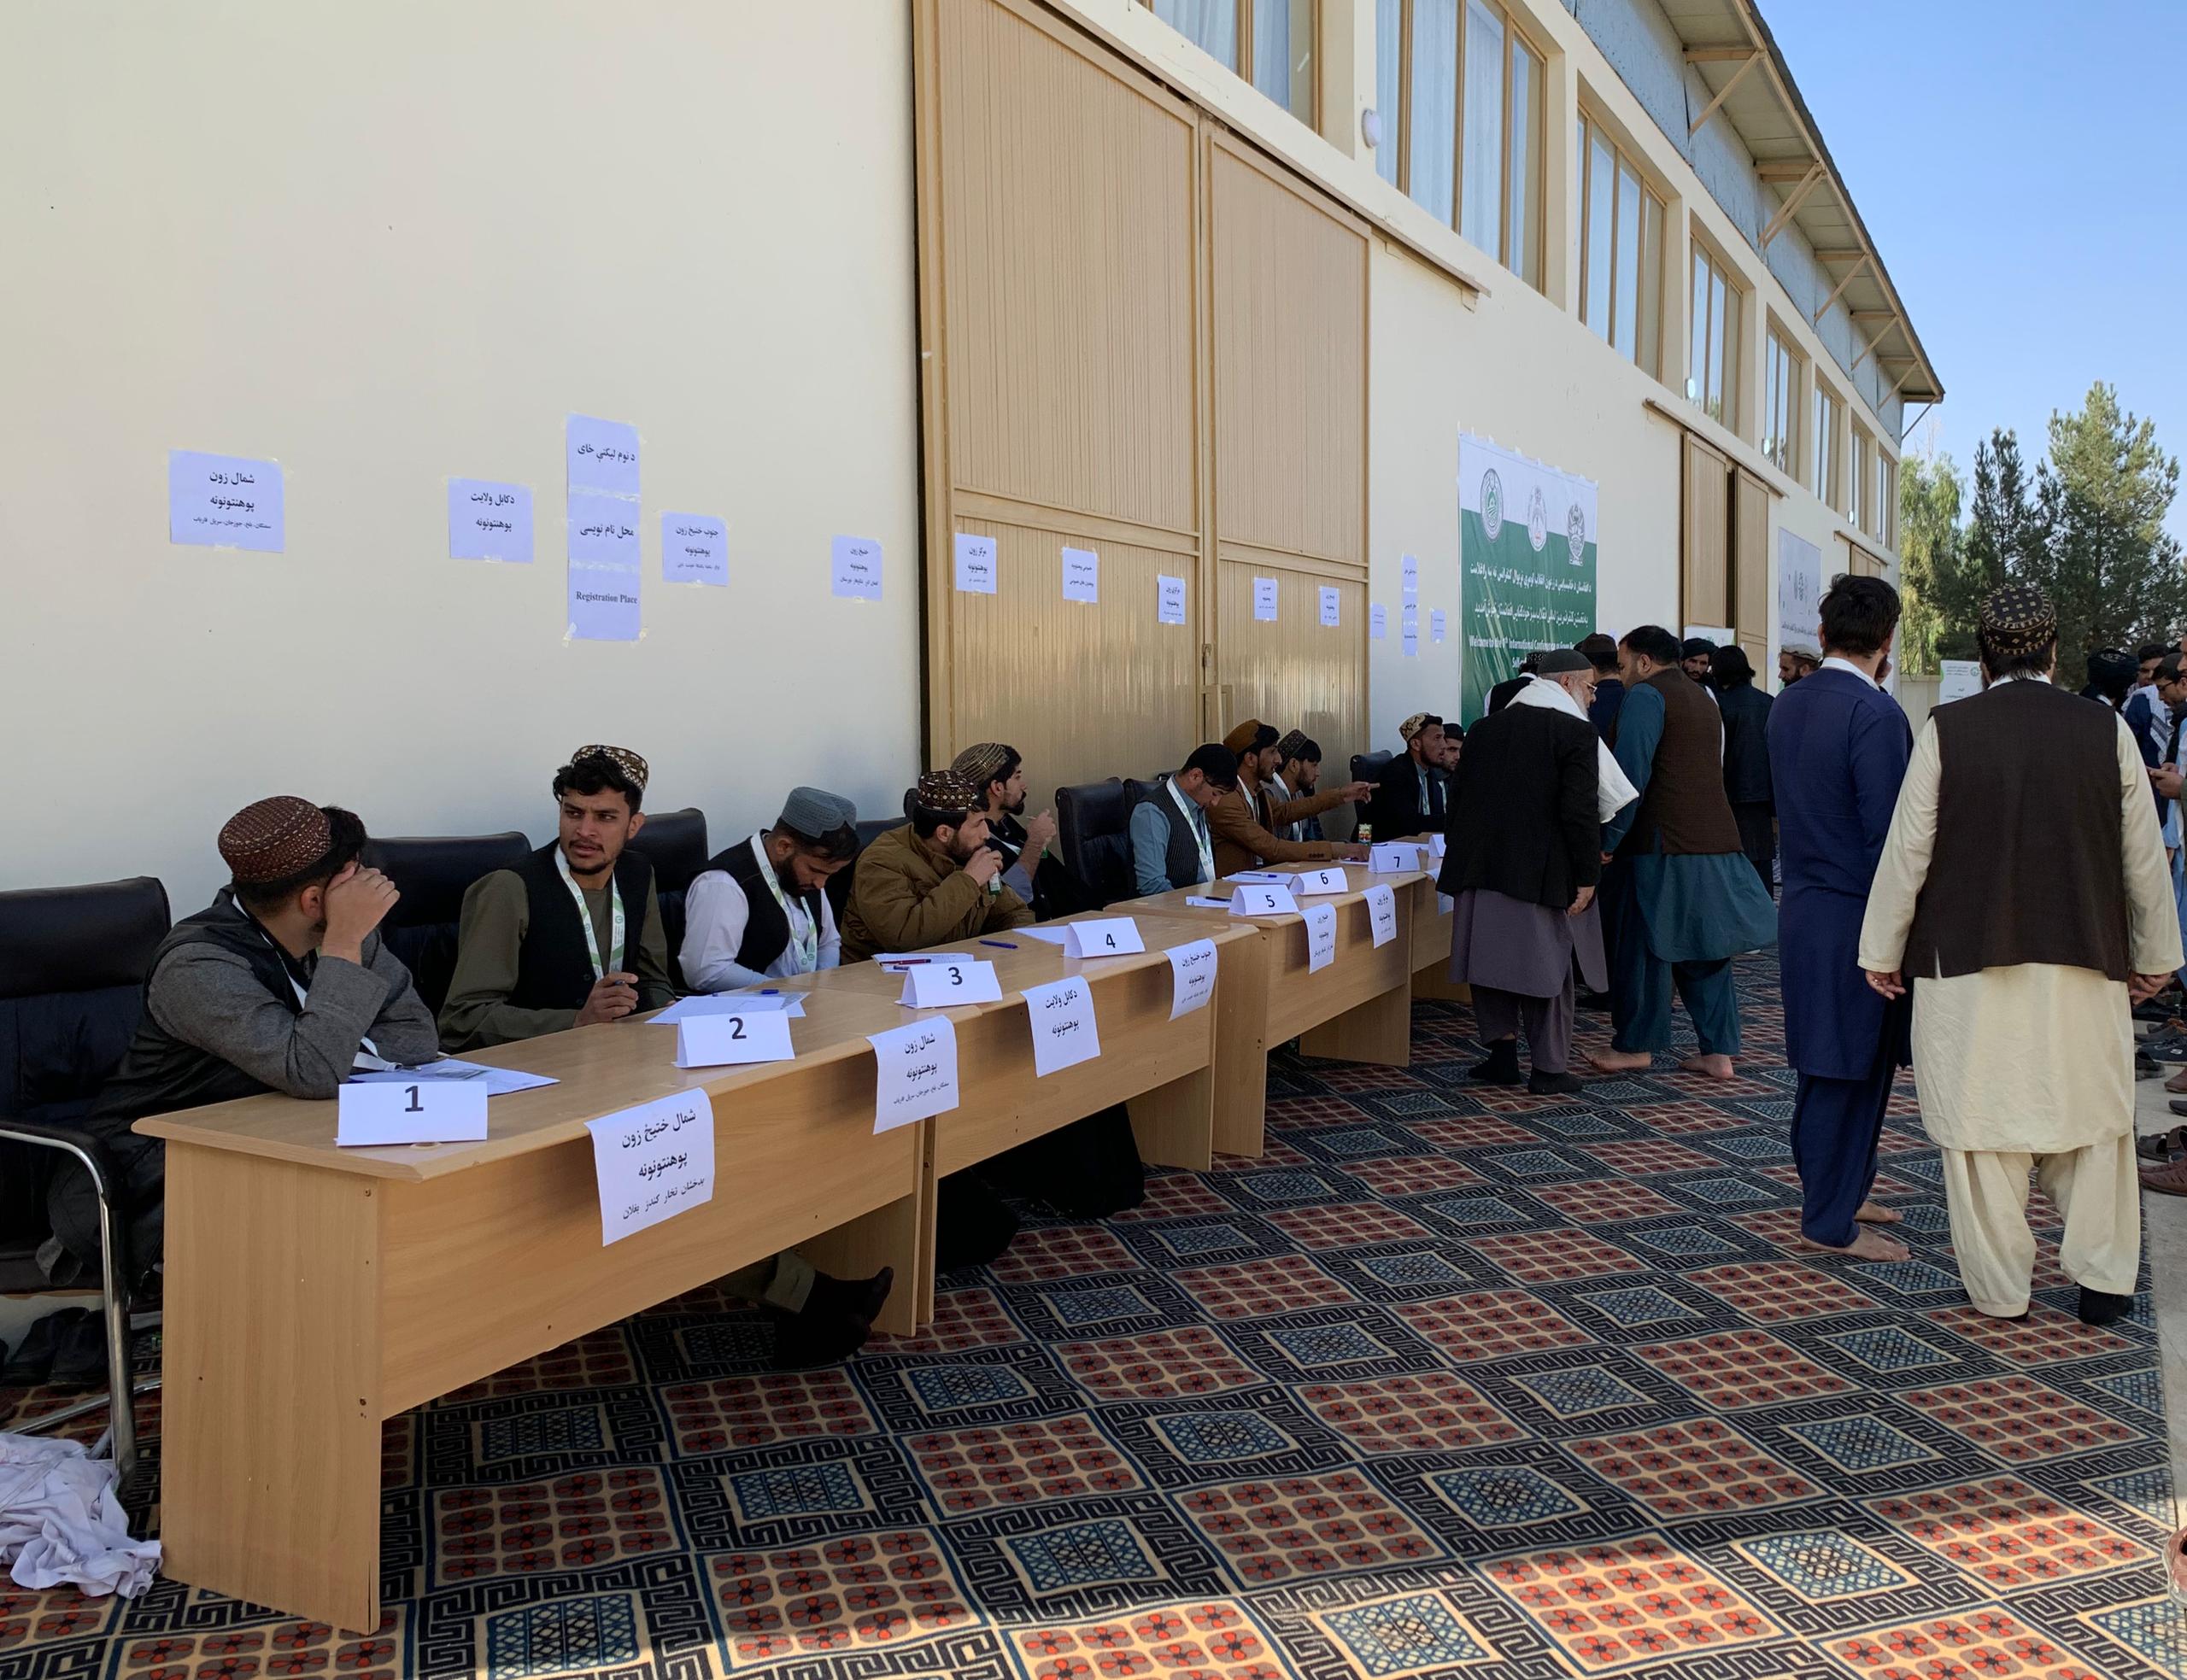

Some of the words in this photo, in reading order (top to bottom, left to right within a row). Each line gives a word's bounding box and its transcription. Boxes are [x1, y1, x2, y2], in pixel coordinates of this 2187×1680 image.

[617, 451, 629, 463] نوم
[209, 471, 228, 483] زون
[231, 472, 255, 485] شمال
[210, 495, 255, 512] پوهنتونونه
[471, 493, 492, 505] ولایت
[476, 518, 512, 532] پوهنتونونه
[605, 524, 615, 535] نام
[617, 525, 635, 539] محل
[576, 590, 619, 603] Registration
[619, 593, 637, 604] Place
[1393, 857, 1401, 868] 7
[1320, 872, 1328, 885] 6
[1265, 894, 1275, 908] 5
[1105, 934, 1116, 948] 4
[948, 967, 963, 985] 3
[1046, 994, 1062, 1009] ولایت
[729, 1017, 747, 1039] 2
[1052, 1020, 1079, 1038] پوهنتونونه
[905, 1040, 918, 1054] زون
[919, 1033, 935, 1051] شمال
[906, 1062, 937, 1081] پوهنتونونه
[405, 1086, 424, 1112] 1
[673, 1109, 696, 1131] شمال
[622, 1130, 641, 1148] زون
[639, 1152, 688, 1180] پوهنتونونه
[681, 1178, 705, 1195] بدخشان
[645, 1194, 660, 1212] کندز
[664, 1188, 677, 1203] تخار
[623, 1204, 639, 1220] بغلان
